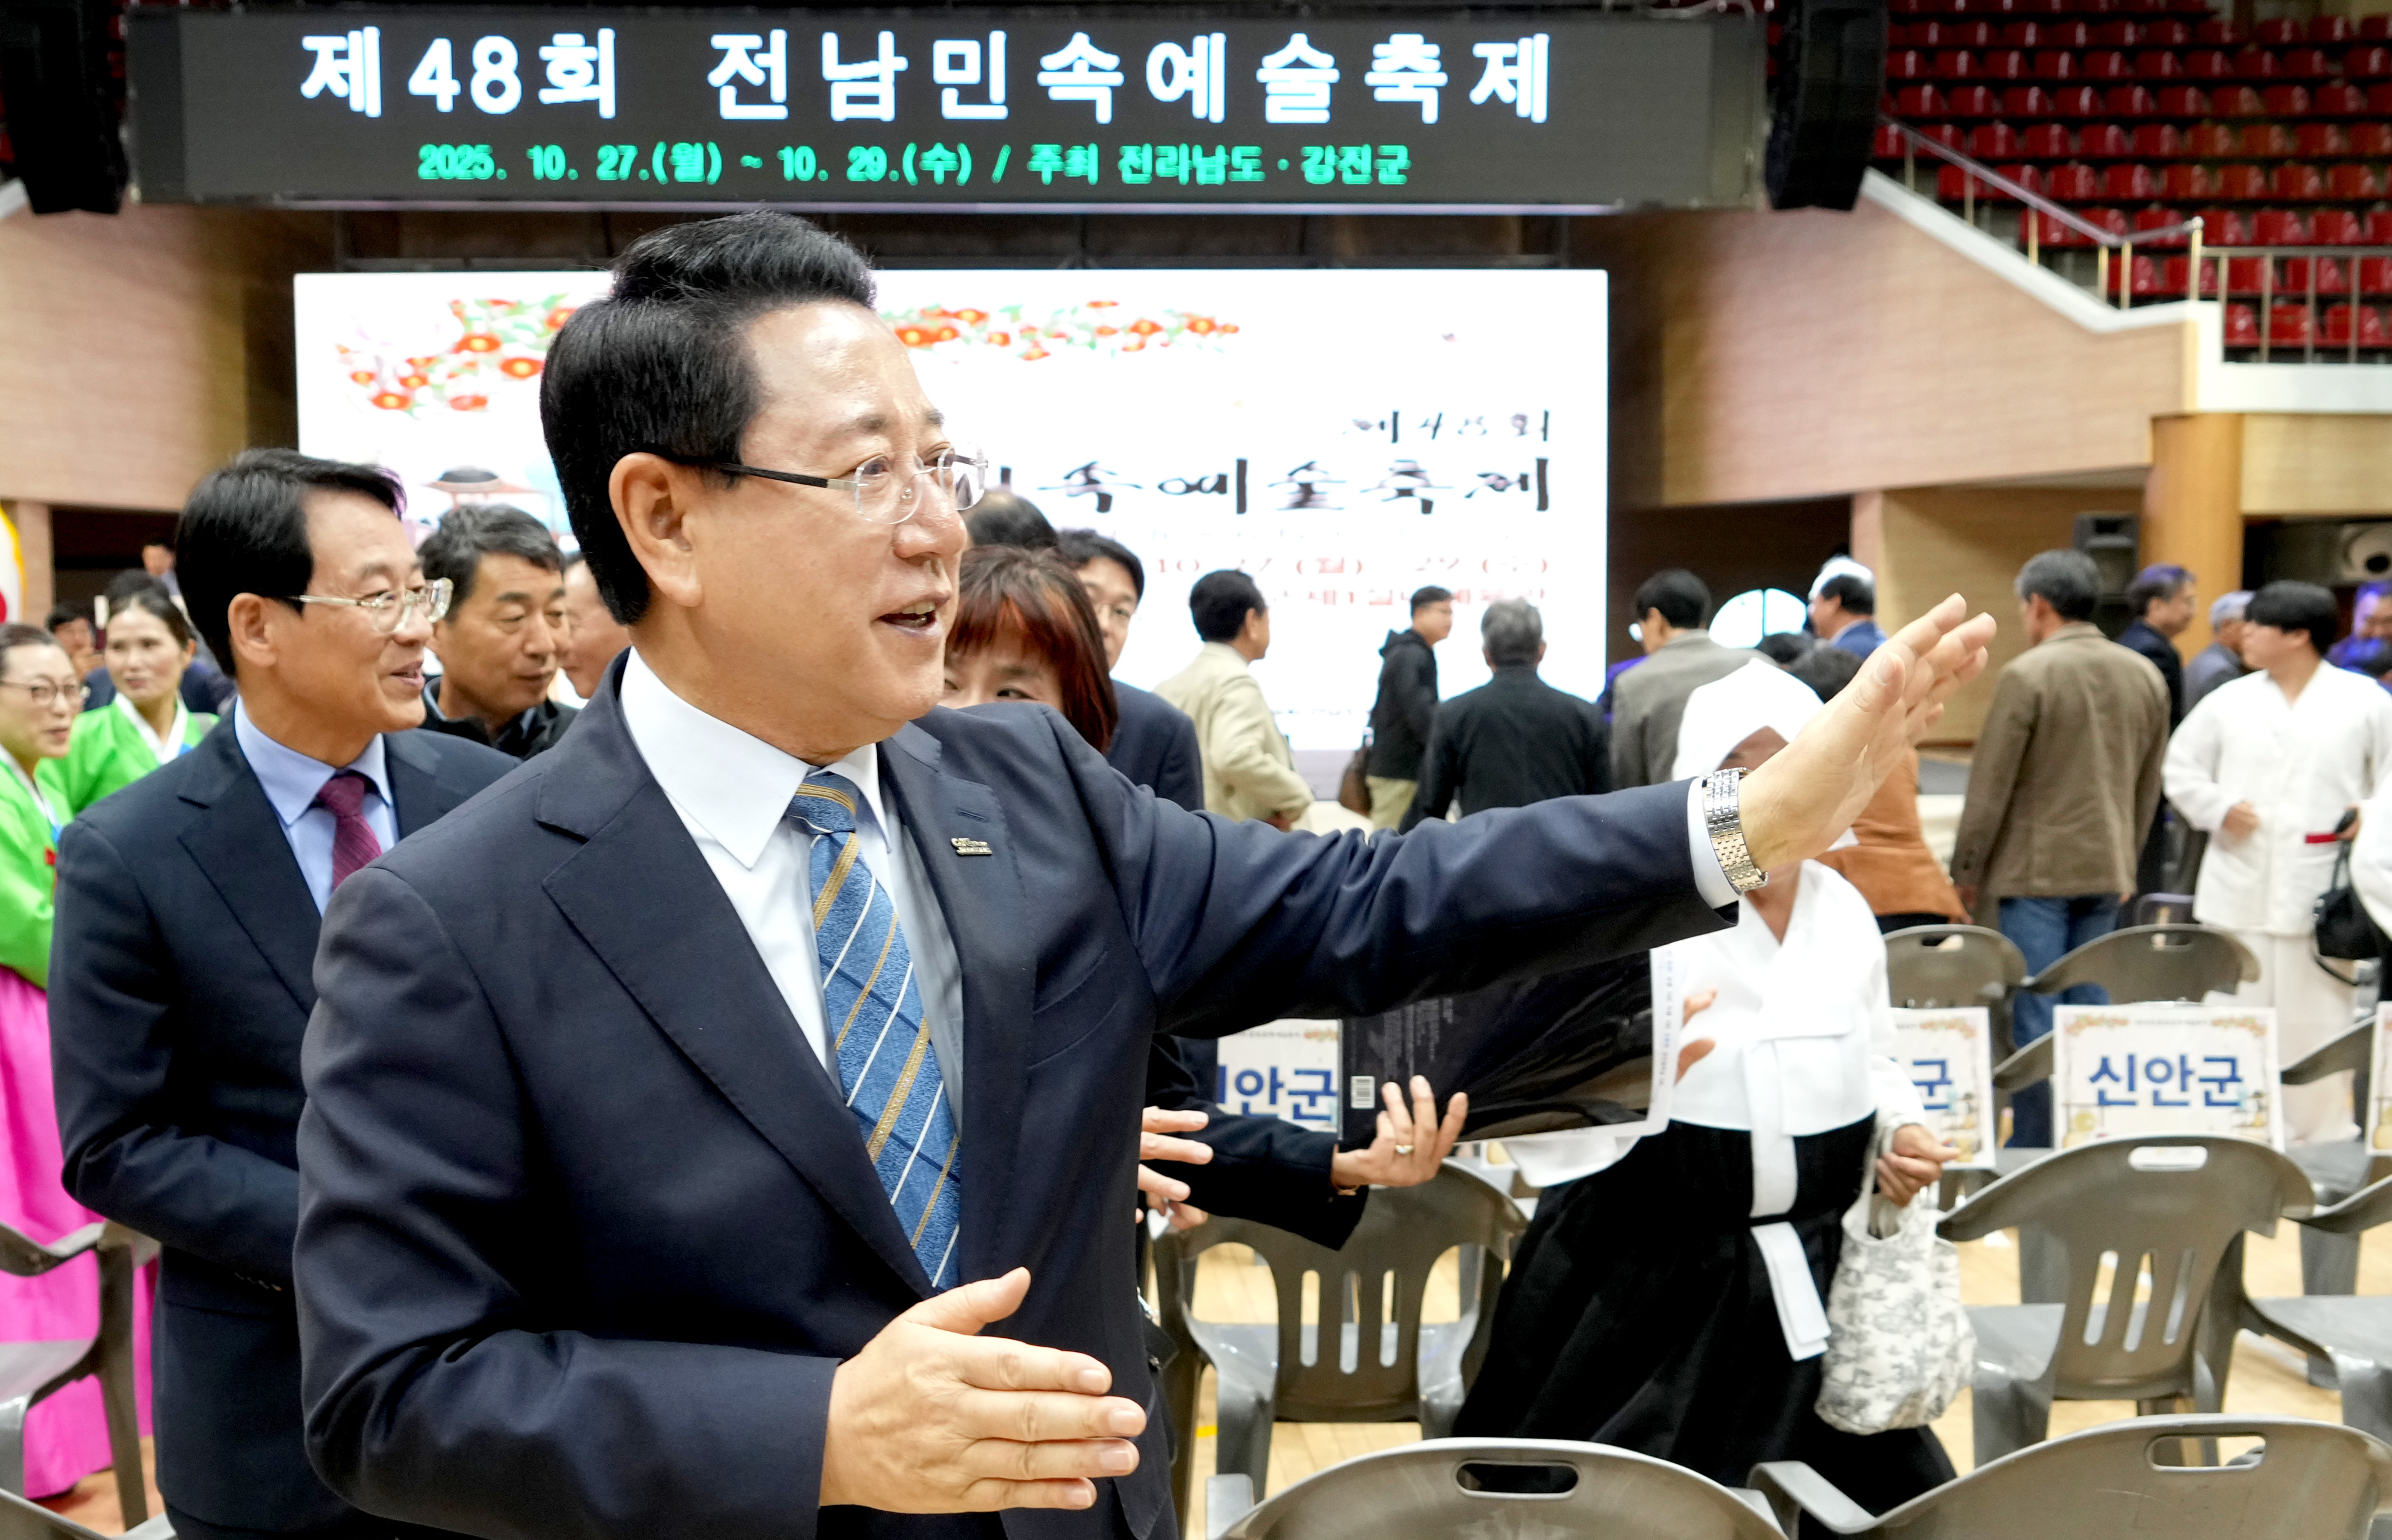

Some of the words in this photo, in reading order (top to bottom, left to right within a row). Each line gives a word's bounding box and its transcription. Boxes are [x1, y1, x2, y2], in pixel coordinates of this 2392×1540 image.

[301, 26, 615, 119] 제48회
[708, 29, 1549, 124] 전남민속예술축제
[418, 144, 507, 180] 2025.
[526, 144, 578, 180] 10.
[777, 146, 828, 181] 10.
[1216, 1064, 1337, 1121] 안군
[2088, 1053, 2243, 1107] 신안군
